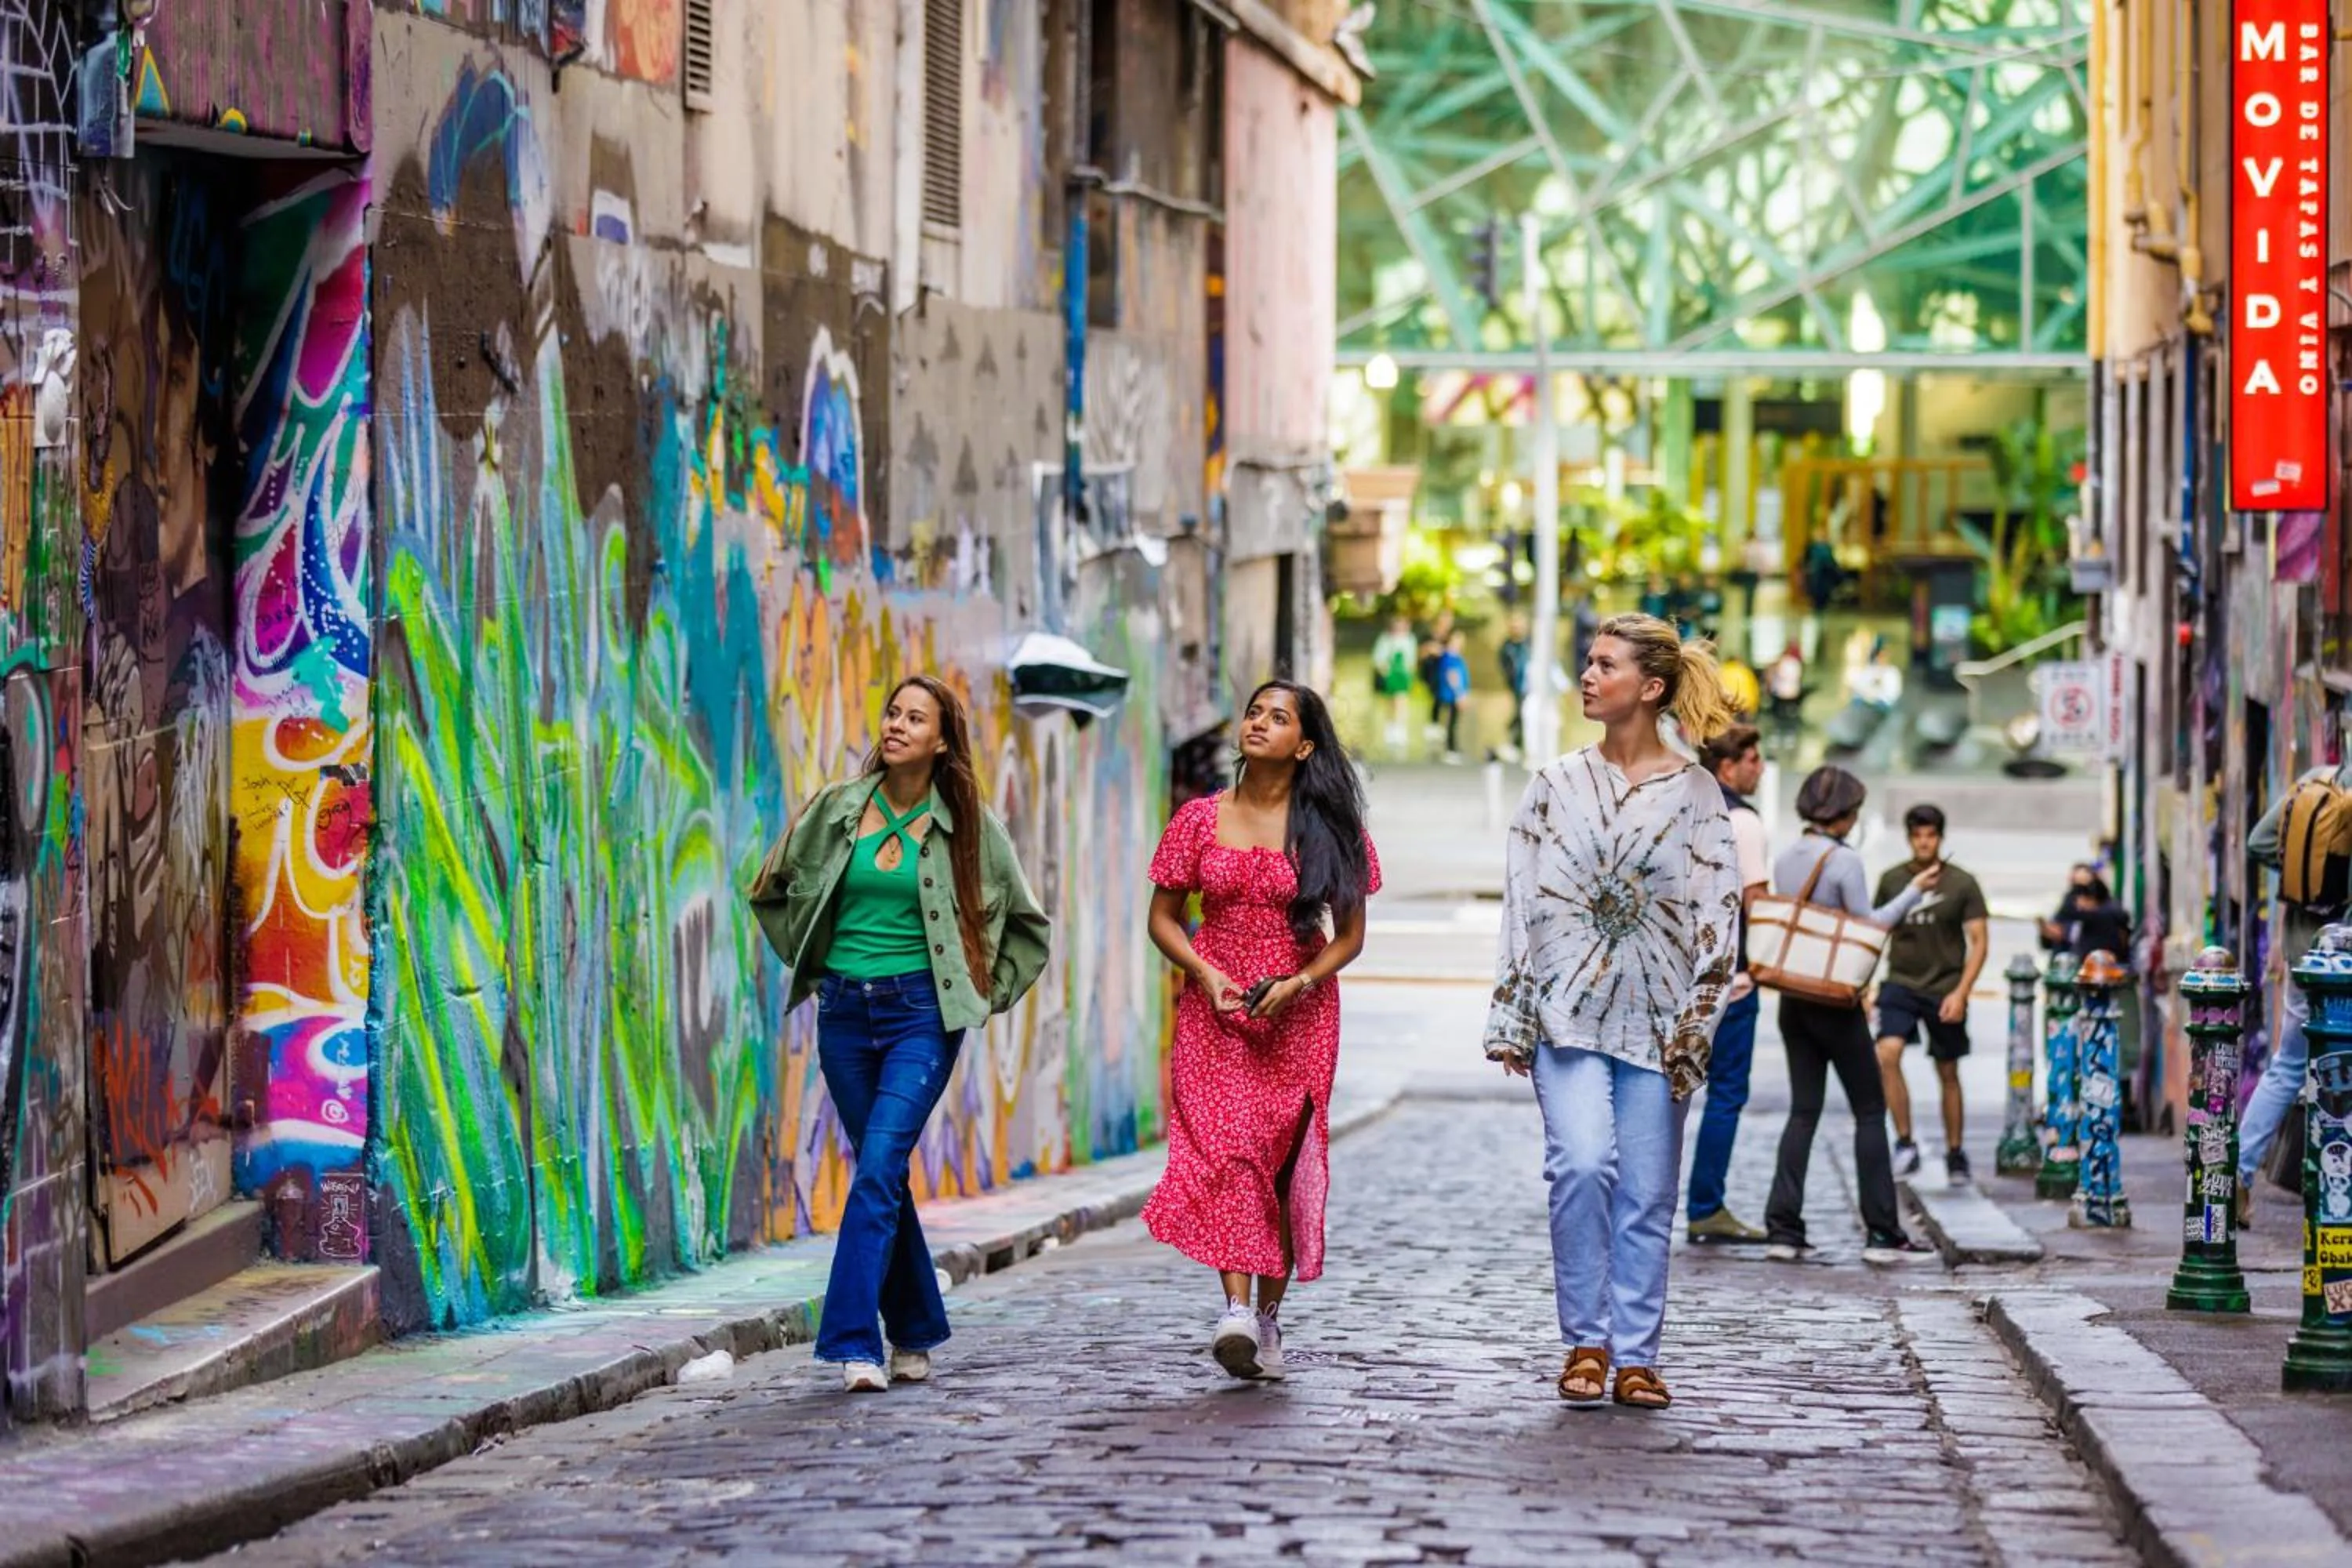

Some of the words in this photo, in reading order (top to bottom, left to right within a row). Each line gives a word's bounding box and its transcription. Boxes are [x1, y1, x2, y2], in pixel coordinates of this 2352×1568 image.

[2299, 24, 2318, 83] BAR
[2299, 101, 2318, 140] DE
[2241, 21, 2285, 394] MOVIDA
[2299, 158, 2318, 259] TAPAS
[2299, 277, 2318, 292] Y
[2299, 312, 2318, 395] VINO
